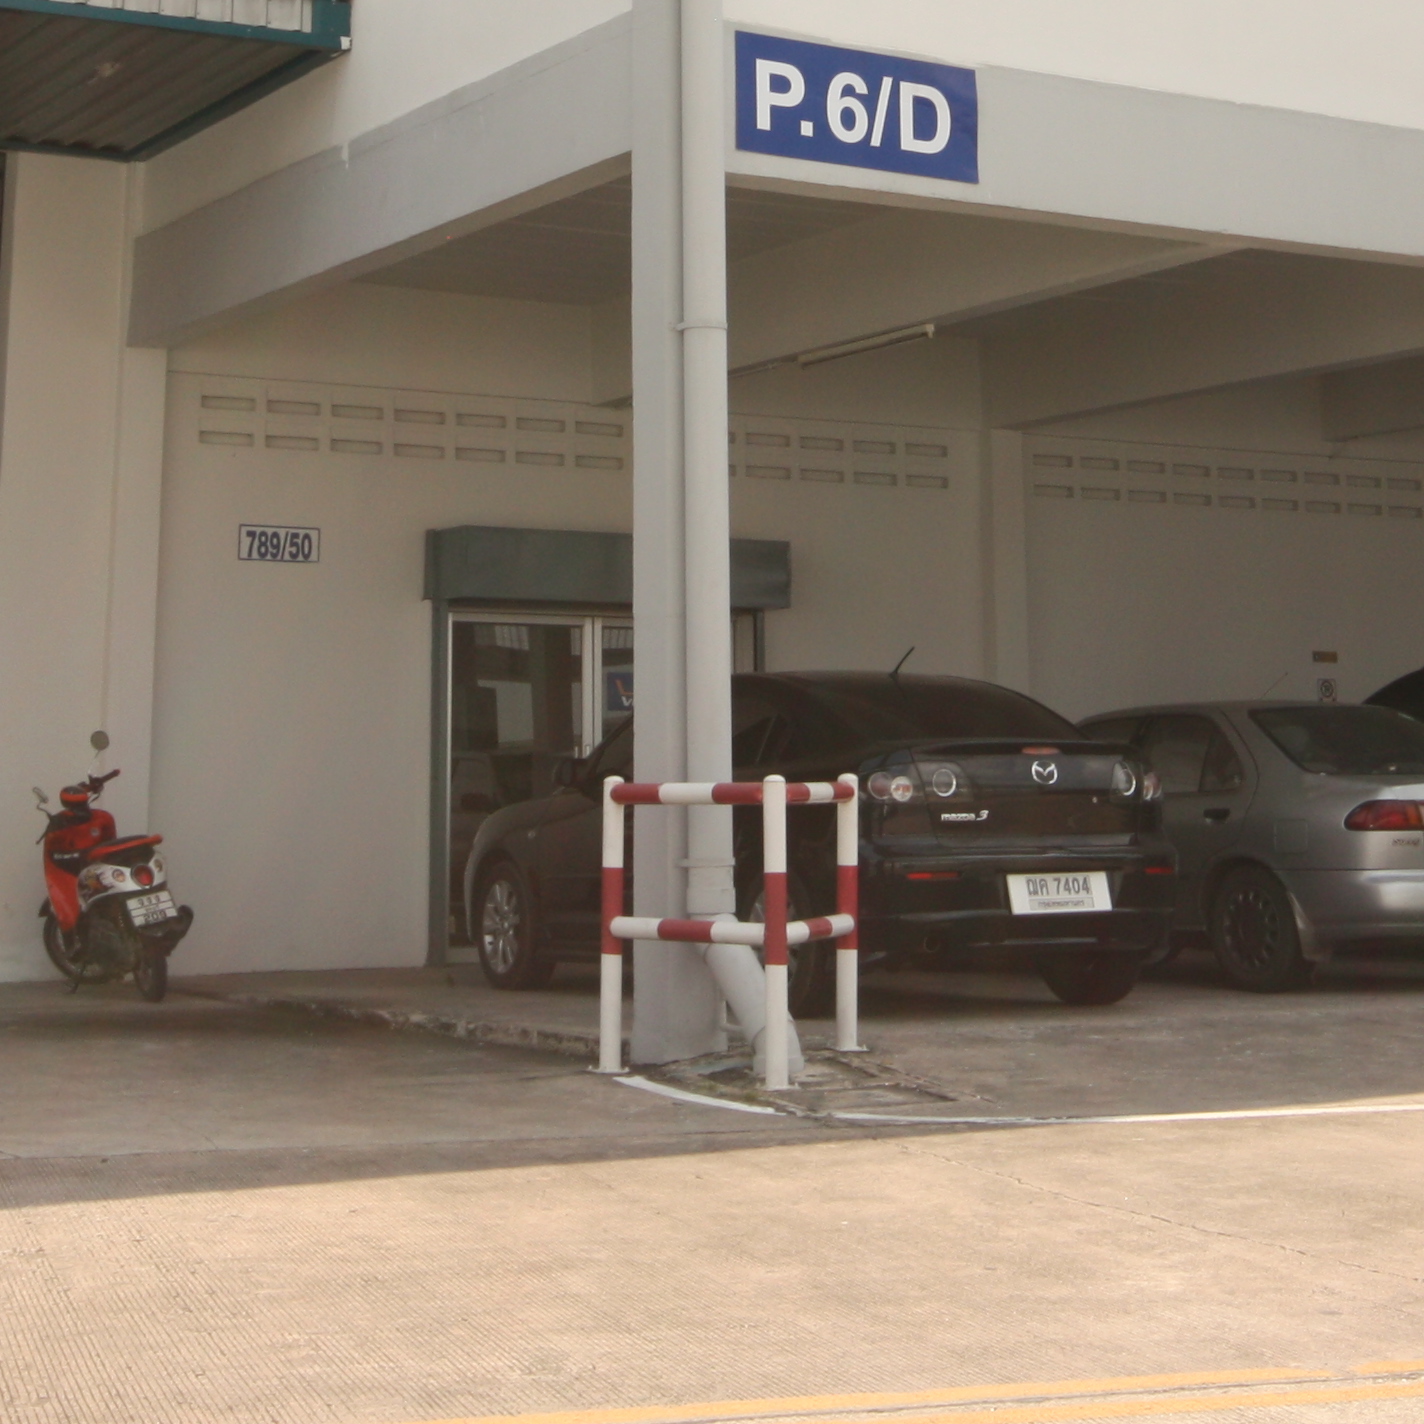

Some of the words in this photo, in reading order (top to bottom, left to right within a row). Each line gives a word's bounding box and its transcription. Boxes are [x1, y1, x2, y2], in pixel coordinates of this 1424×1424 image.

[755, 57, 952, 155] P.6/D
[245, 529, 313, 562] 789/50
[1052, 876, 1090, 896] 7404
